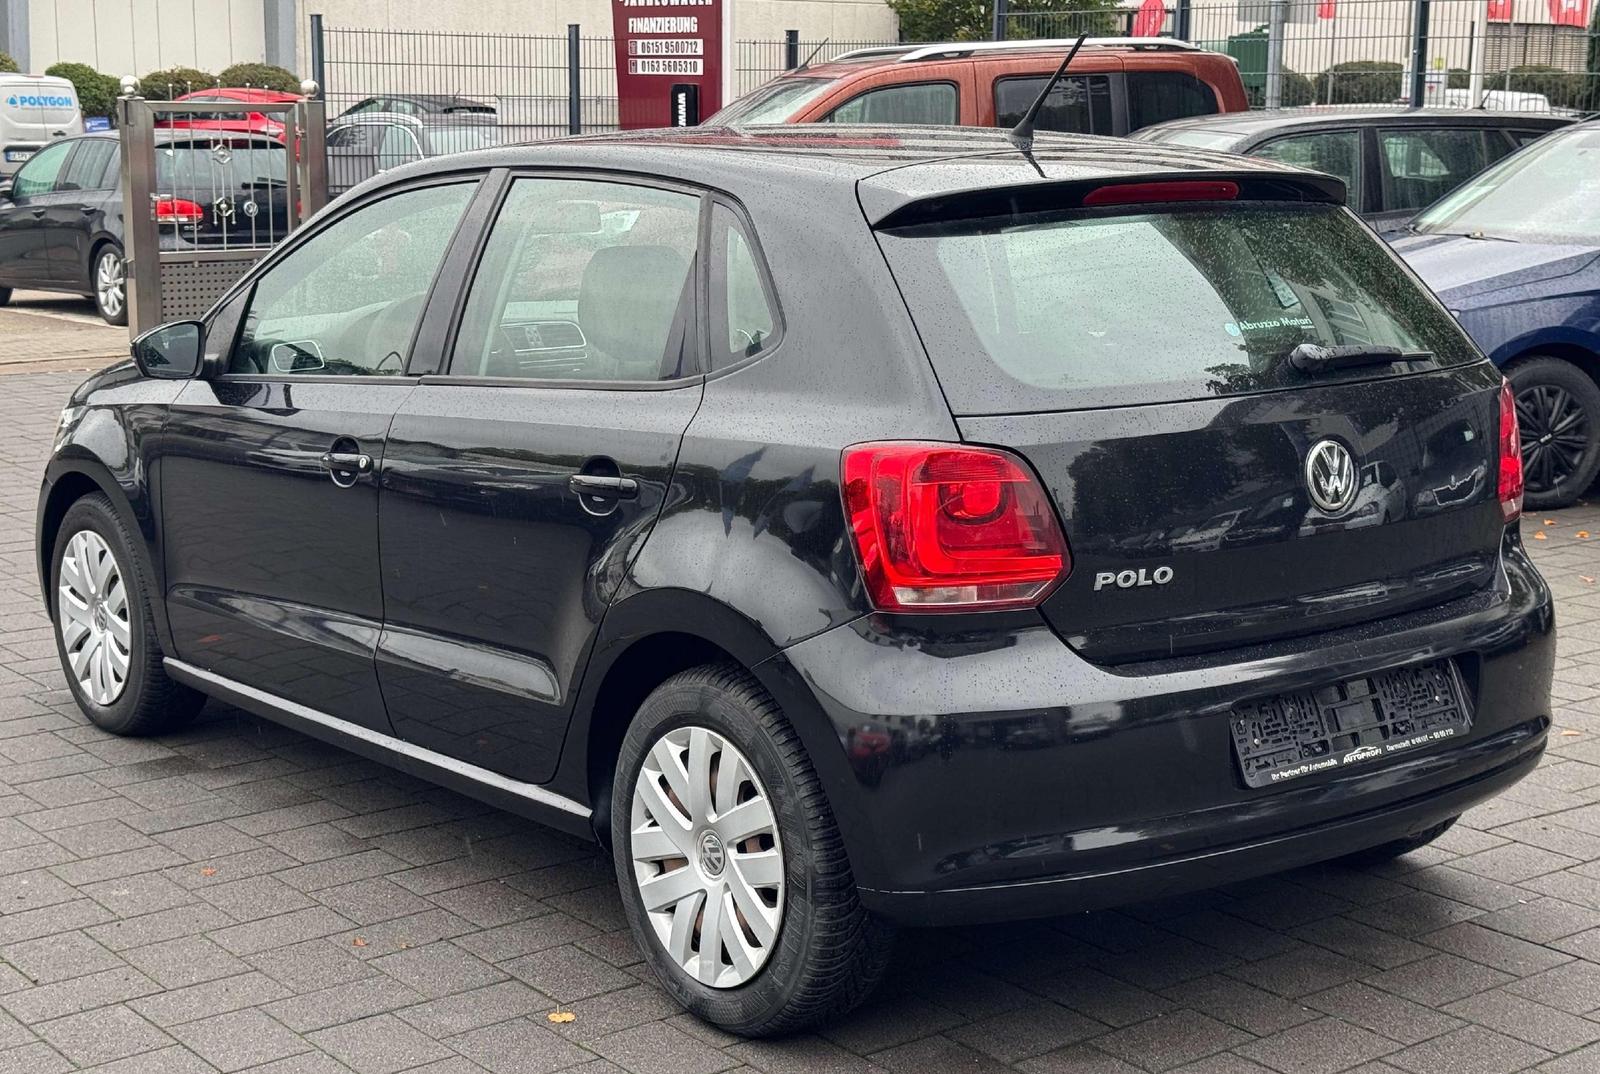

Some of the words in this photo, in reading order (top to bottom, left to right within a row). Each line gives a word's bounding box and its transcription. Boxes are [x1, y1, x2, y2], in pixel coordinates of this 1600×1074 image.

[628, 16, 698, 33] FINANZIERUNG
[641, 60, 660, 73] 0163
[661, 60, 698, 73] 5605310
[20, 96, 72, 106] POLYGON
[1093, 566, 1174, 591] POLO
